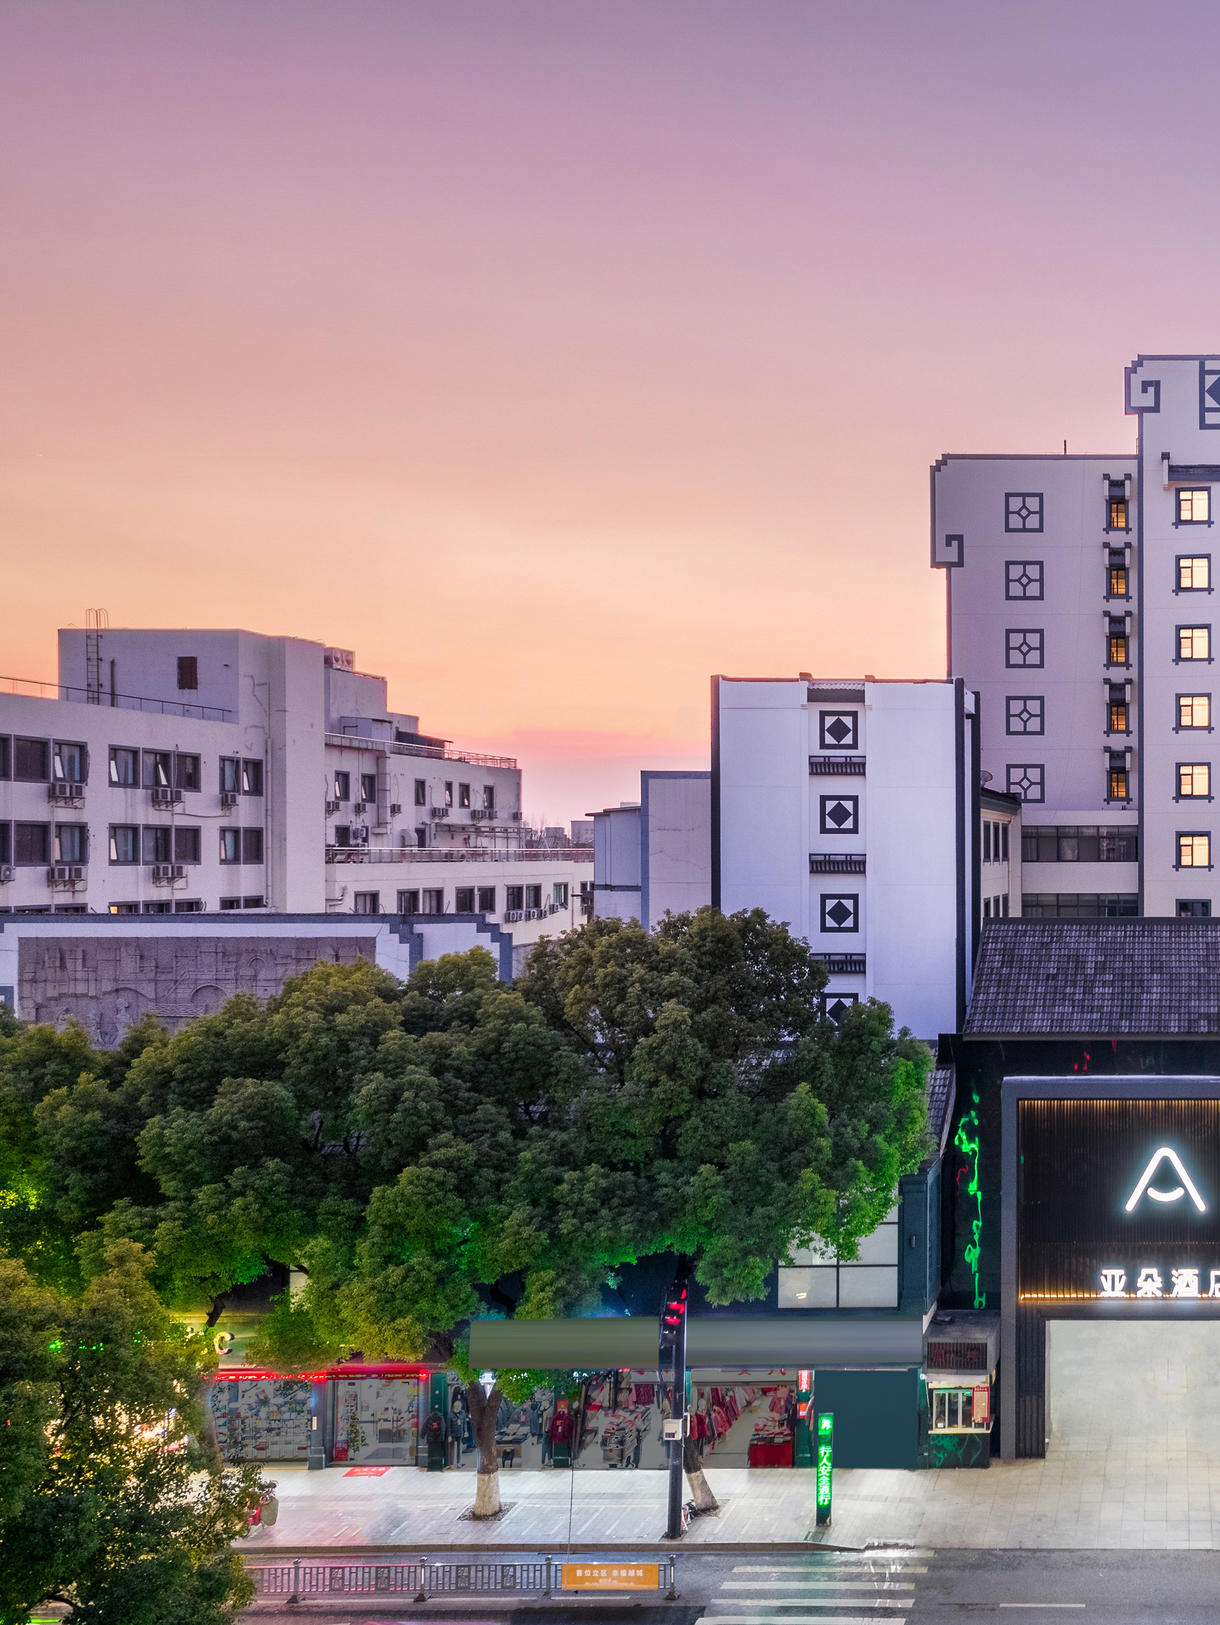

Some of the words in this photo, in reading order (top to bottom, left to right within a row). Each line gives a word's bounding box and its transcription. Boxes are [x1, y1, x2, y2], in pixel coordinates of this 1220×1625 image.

[819, 1446, 832, 1505] 行人安全通行
